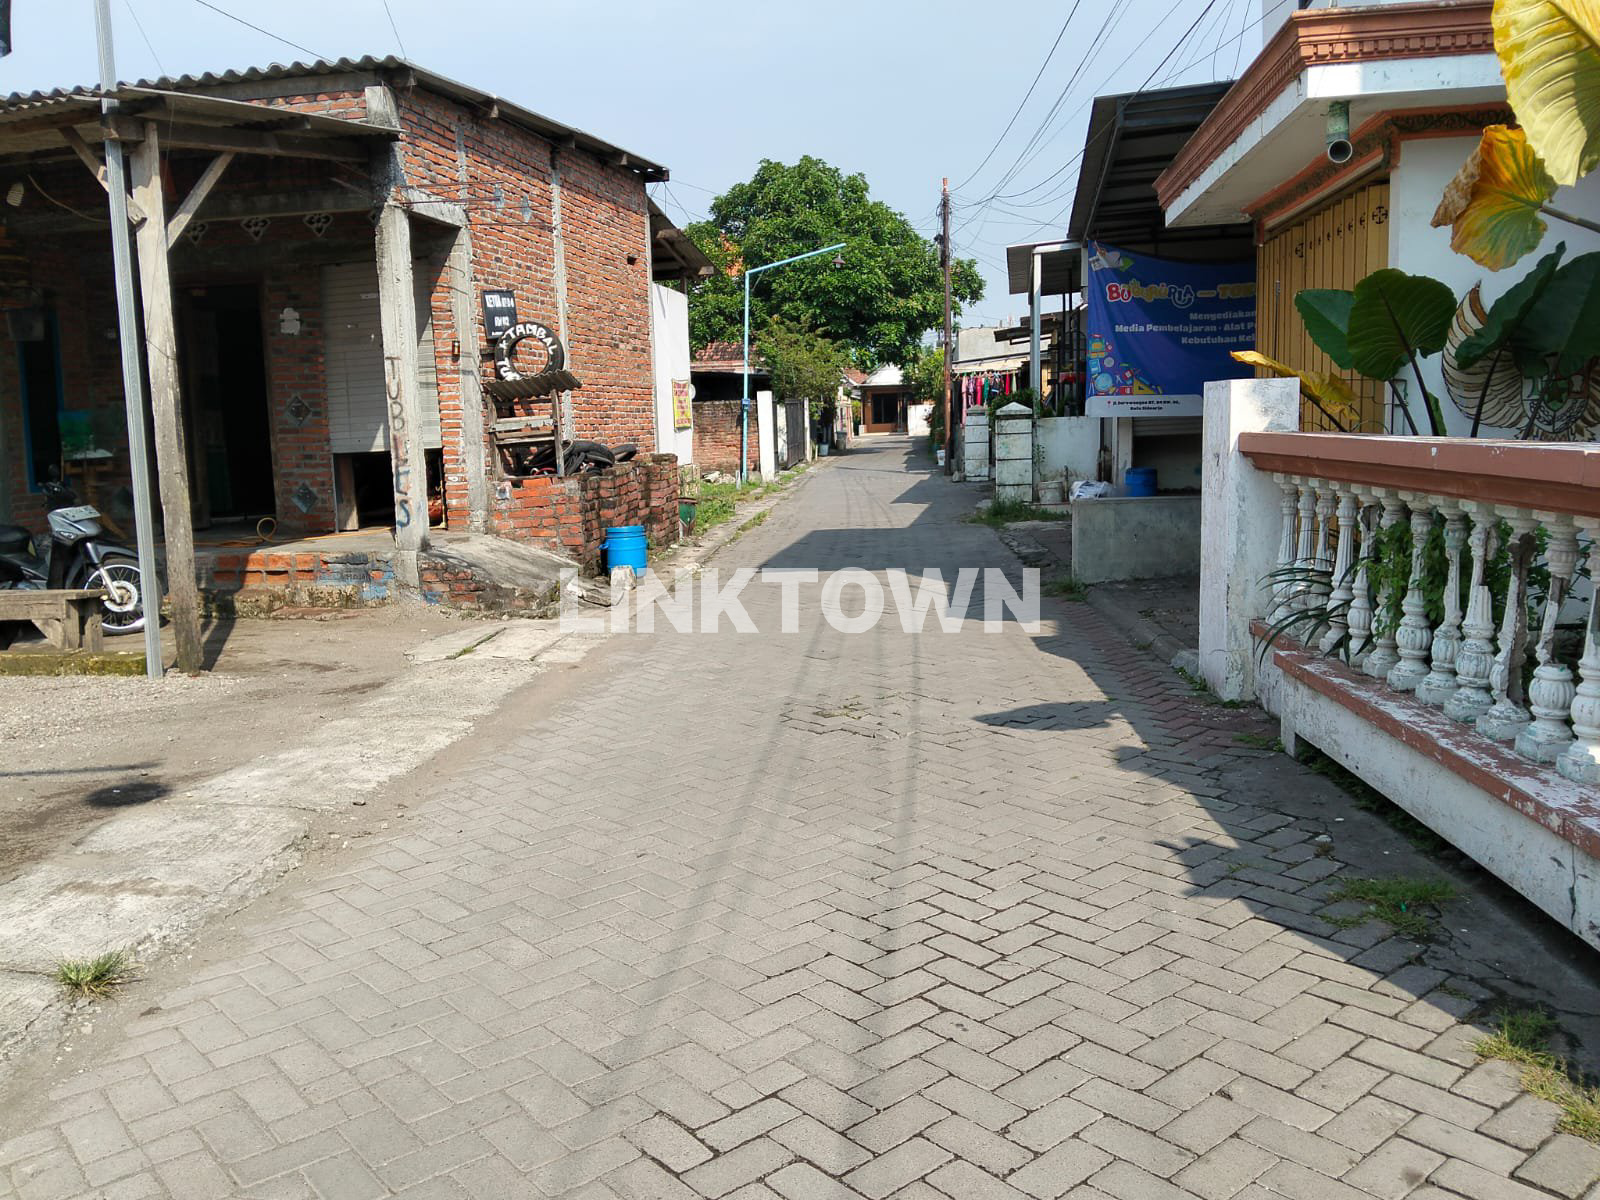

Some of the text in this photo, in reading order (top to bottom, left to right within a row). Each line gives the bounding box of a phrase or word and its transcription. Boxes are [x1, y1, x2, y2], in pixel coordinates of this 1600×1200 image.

[1115, 323, 1145, 333] Media
[1146, 323, 1217, 334] Pembelajaran
[1223, 322, 1246, 331] Alat
[501, 323, 558, 355] TAMBAL
[1181, 335, 1237, 344] Kebutuhan
